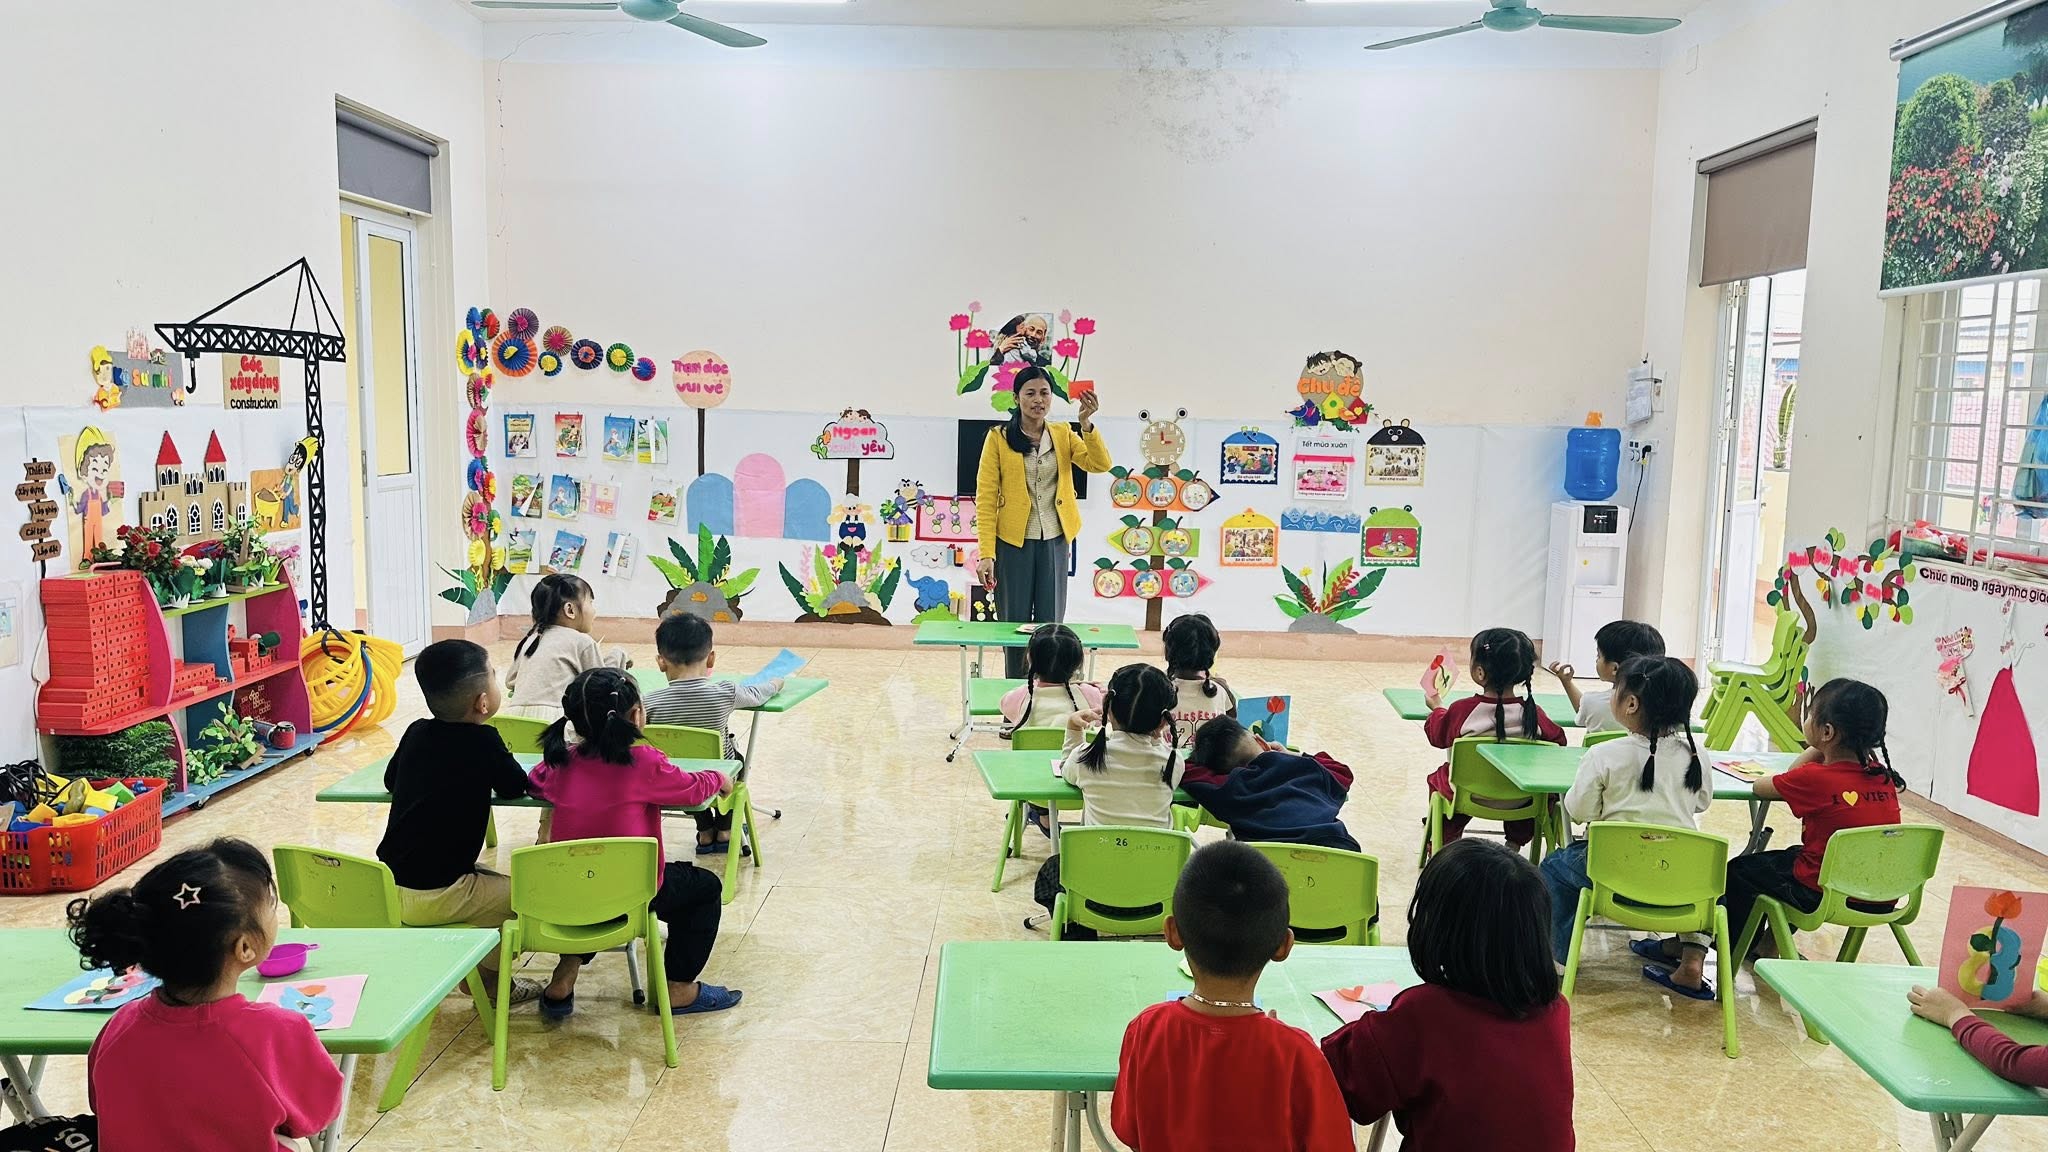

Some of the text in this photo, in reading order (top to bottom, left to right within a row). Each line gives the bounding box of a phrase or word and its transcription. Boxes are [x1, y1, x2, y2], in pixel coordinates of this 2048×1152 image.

[241, 355, 263, 373] Góc
[230, 371, 252, 394] xây
[676, 382, 701, 392] vui
[230, 397, 279, 410] construction
[833, 426, 877, 440] Ngoan
[862, 440, 886, 455] yêu
[1116, 838, 1128, 847] 26
